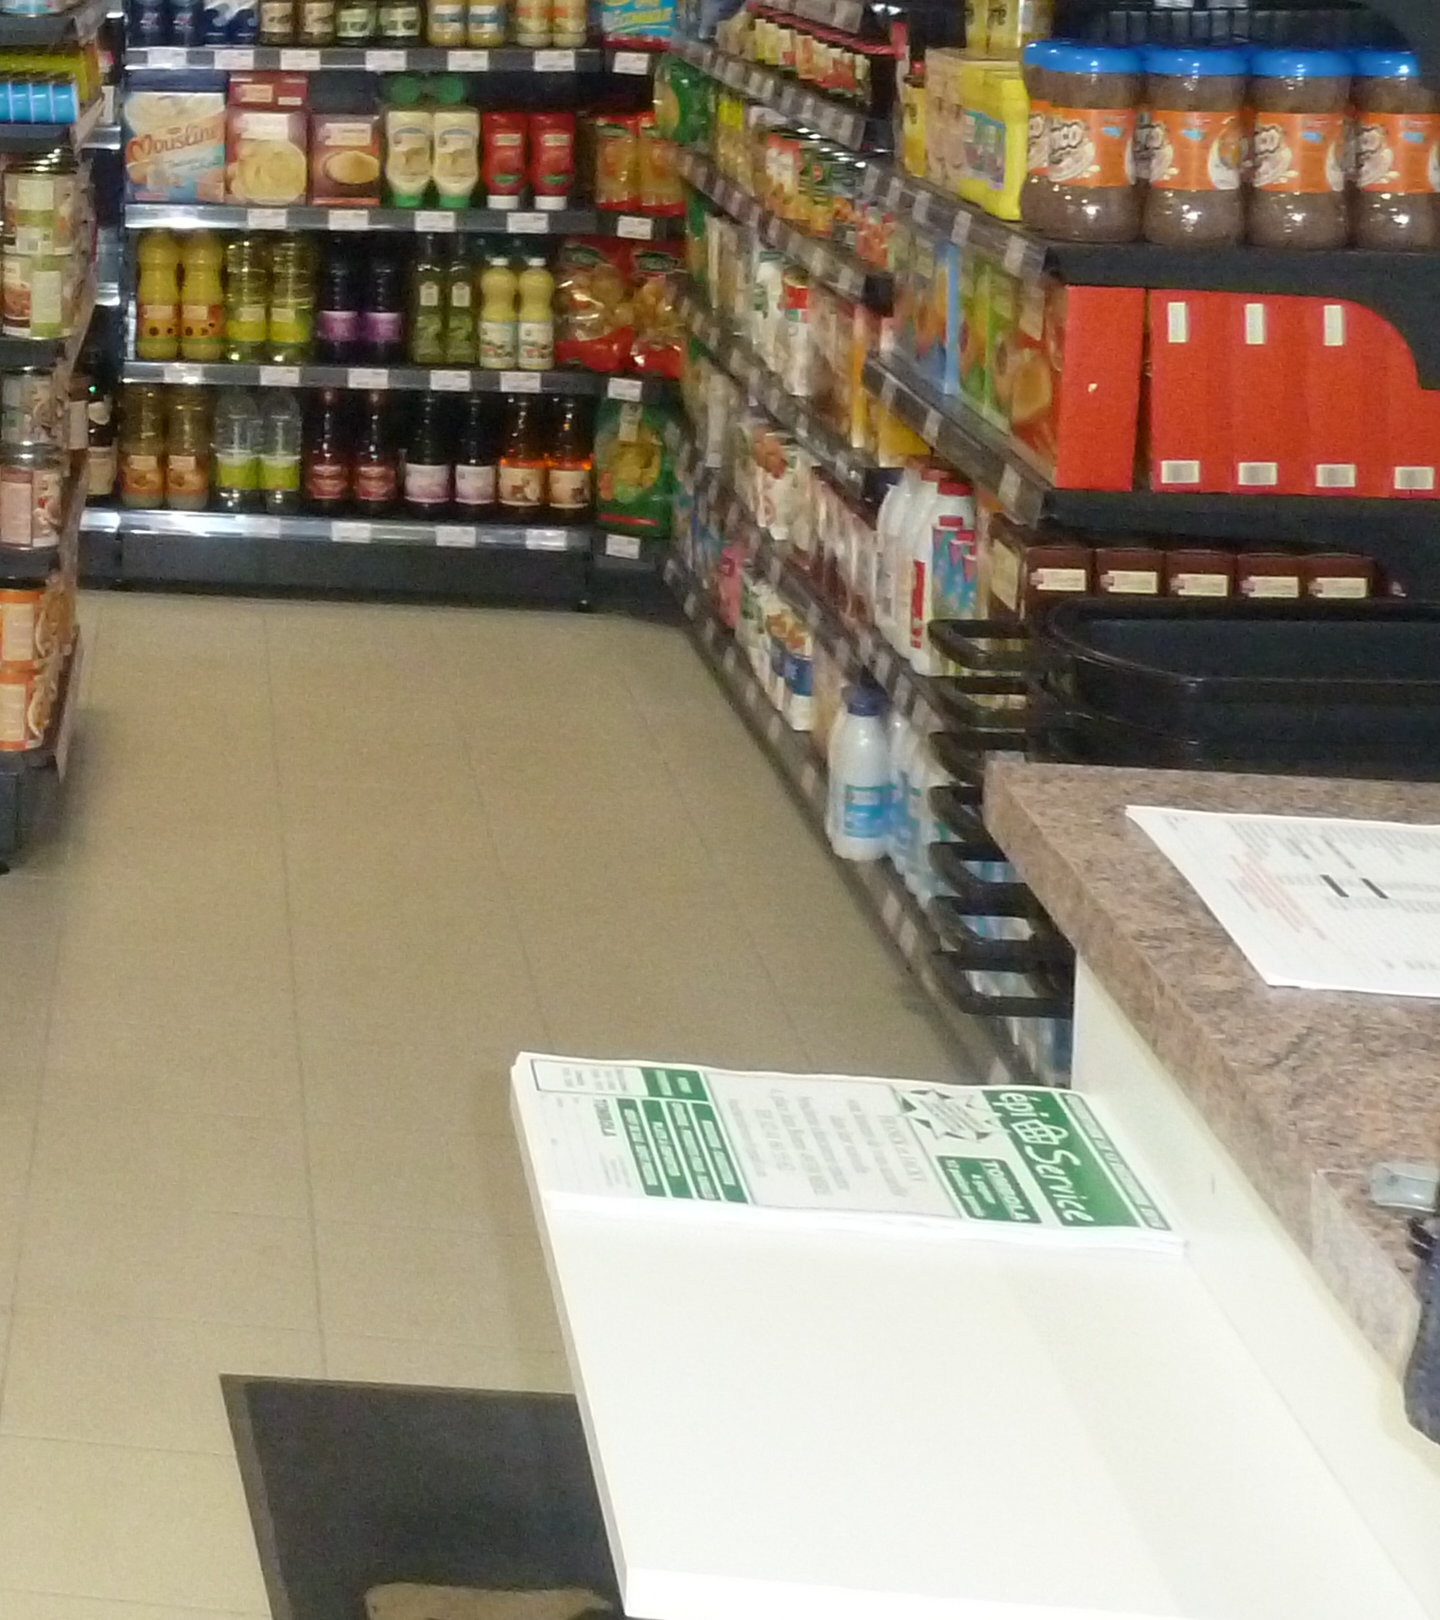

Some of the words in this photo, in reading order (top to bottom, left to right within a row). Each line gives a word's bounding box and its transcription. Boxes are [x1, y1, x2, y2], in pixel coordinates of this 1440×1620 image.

[982, 1160, 1031, 1221] TOMBOLA
[992, 1092, 1049, 1118] épi
[1024, 1145, 1094, 1222] Service
